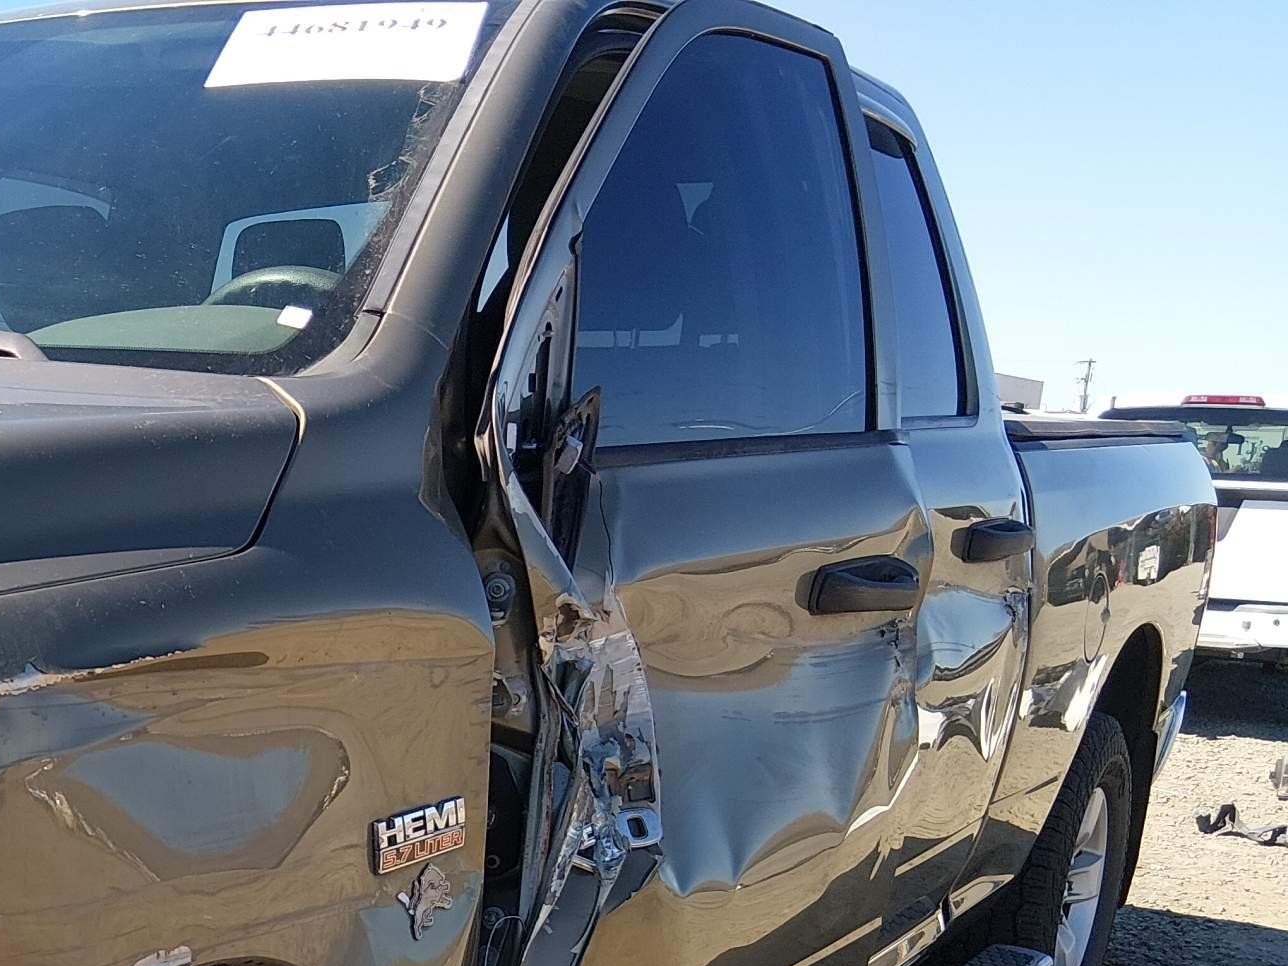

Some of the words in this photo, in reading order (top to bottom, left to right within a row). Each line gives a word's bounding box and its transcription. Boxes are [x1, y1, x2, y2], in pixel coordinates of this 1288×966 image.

[376, 797, 466, 848] HEMI
[382, 846, 412, 869] 5.7
[414, 829, 462, 857] LITER
